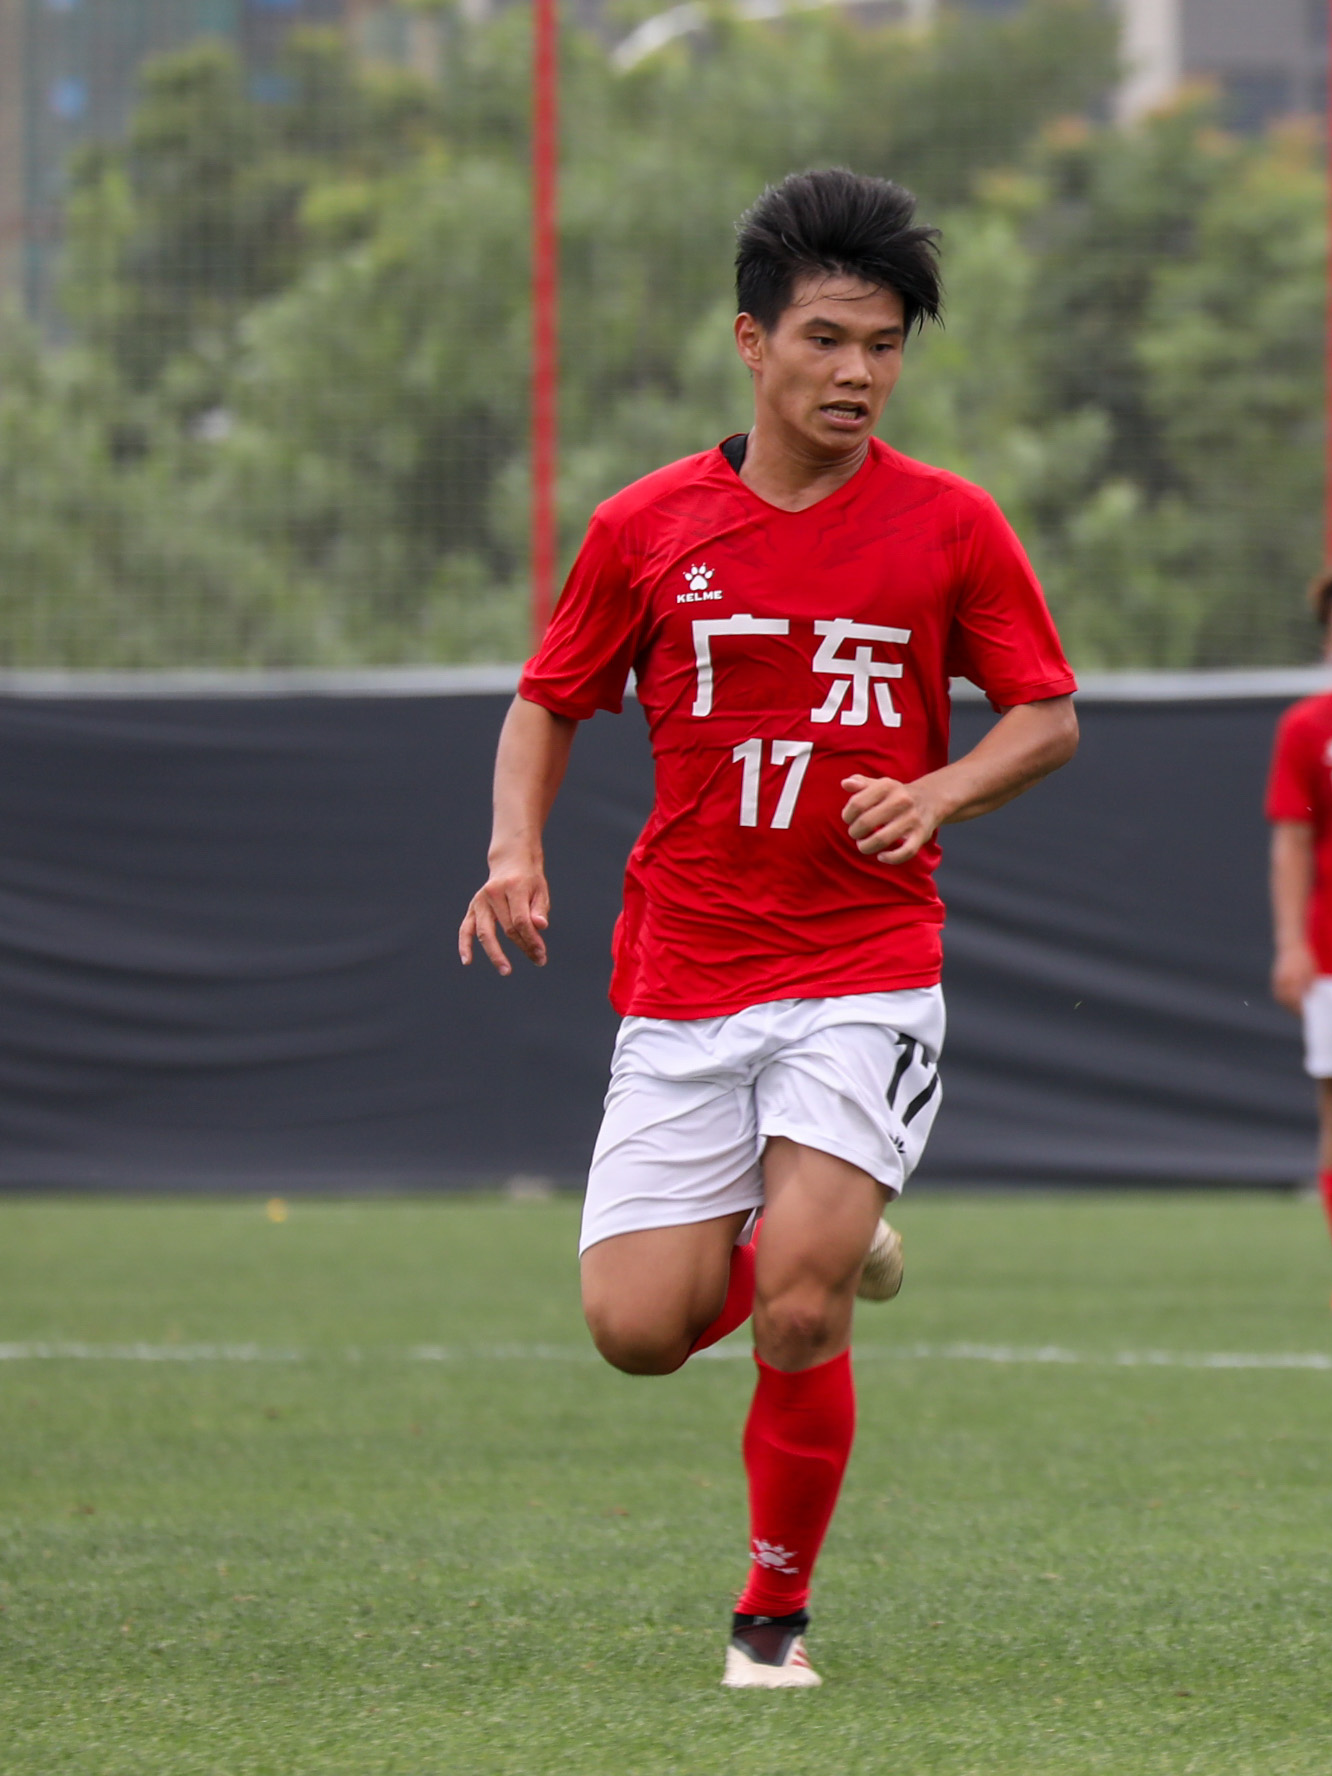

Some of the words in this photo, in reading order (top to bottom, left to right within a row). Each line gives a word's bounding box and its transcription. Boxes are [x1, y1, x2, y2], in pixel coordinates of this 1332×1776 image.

[676, 590, 723, 604] KELME
[692, 613, 911, 727] 广东
[732, 738, 814, 829] 17
[886, 1032, 939, 1128] 17
